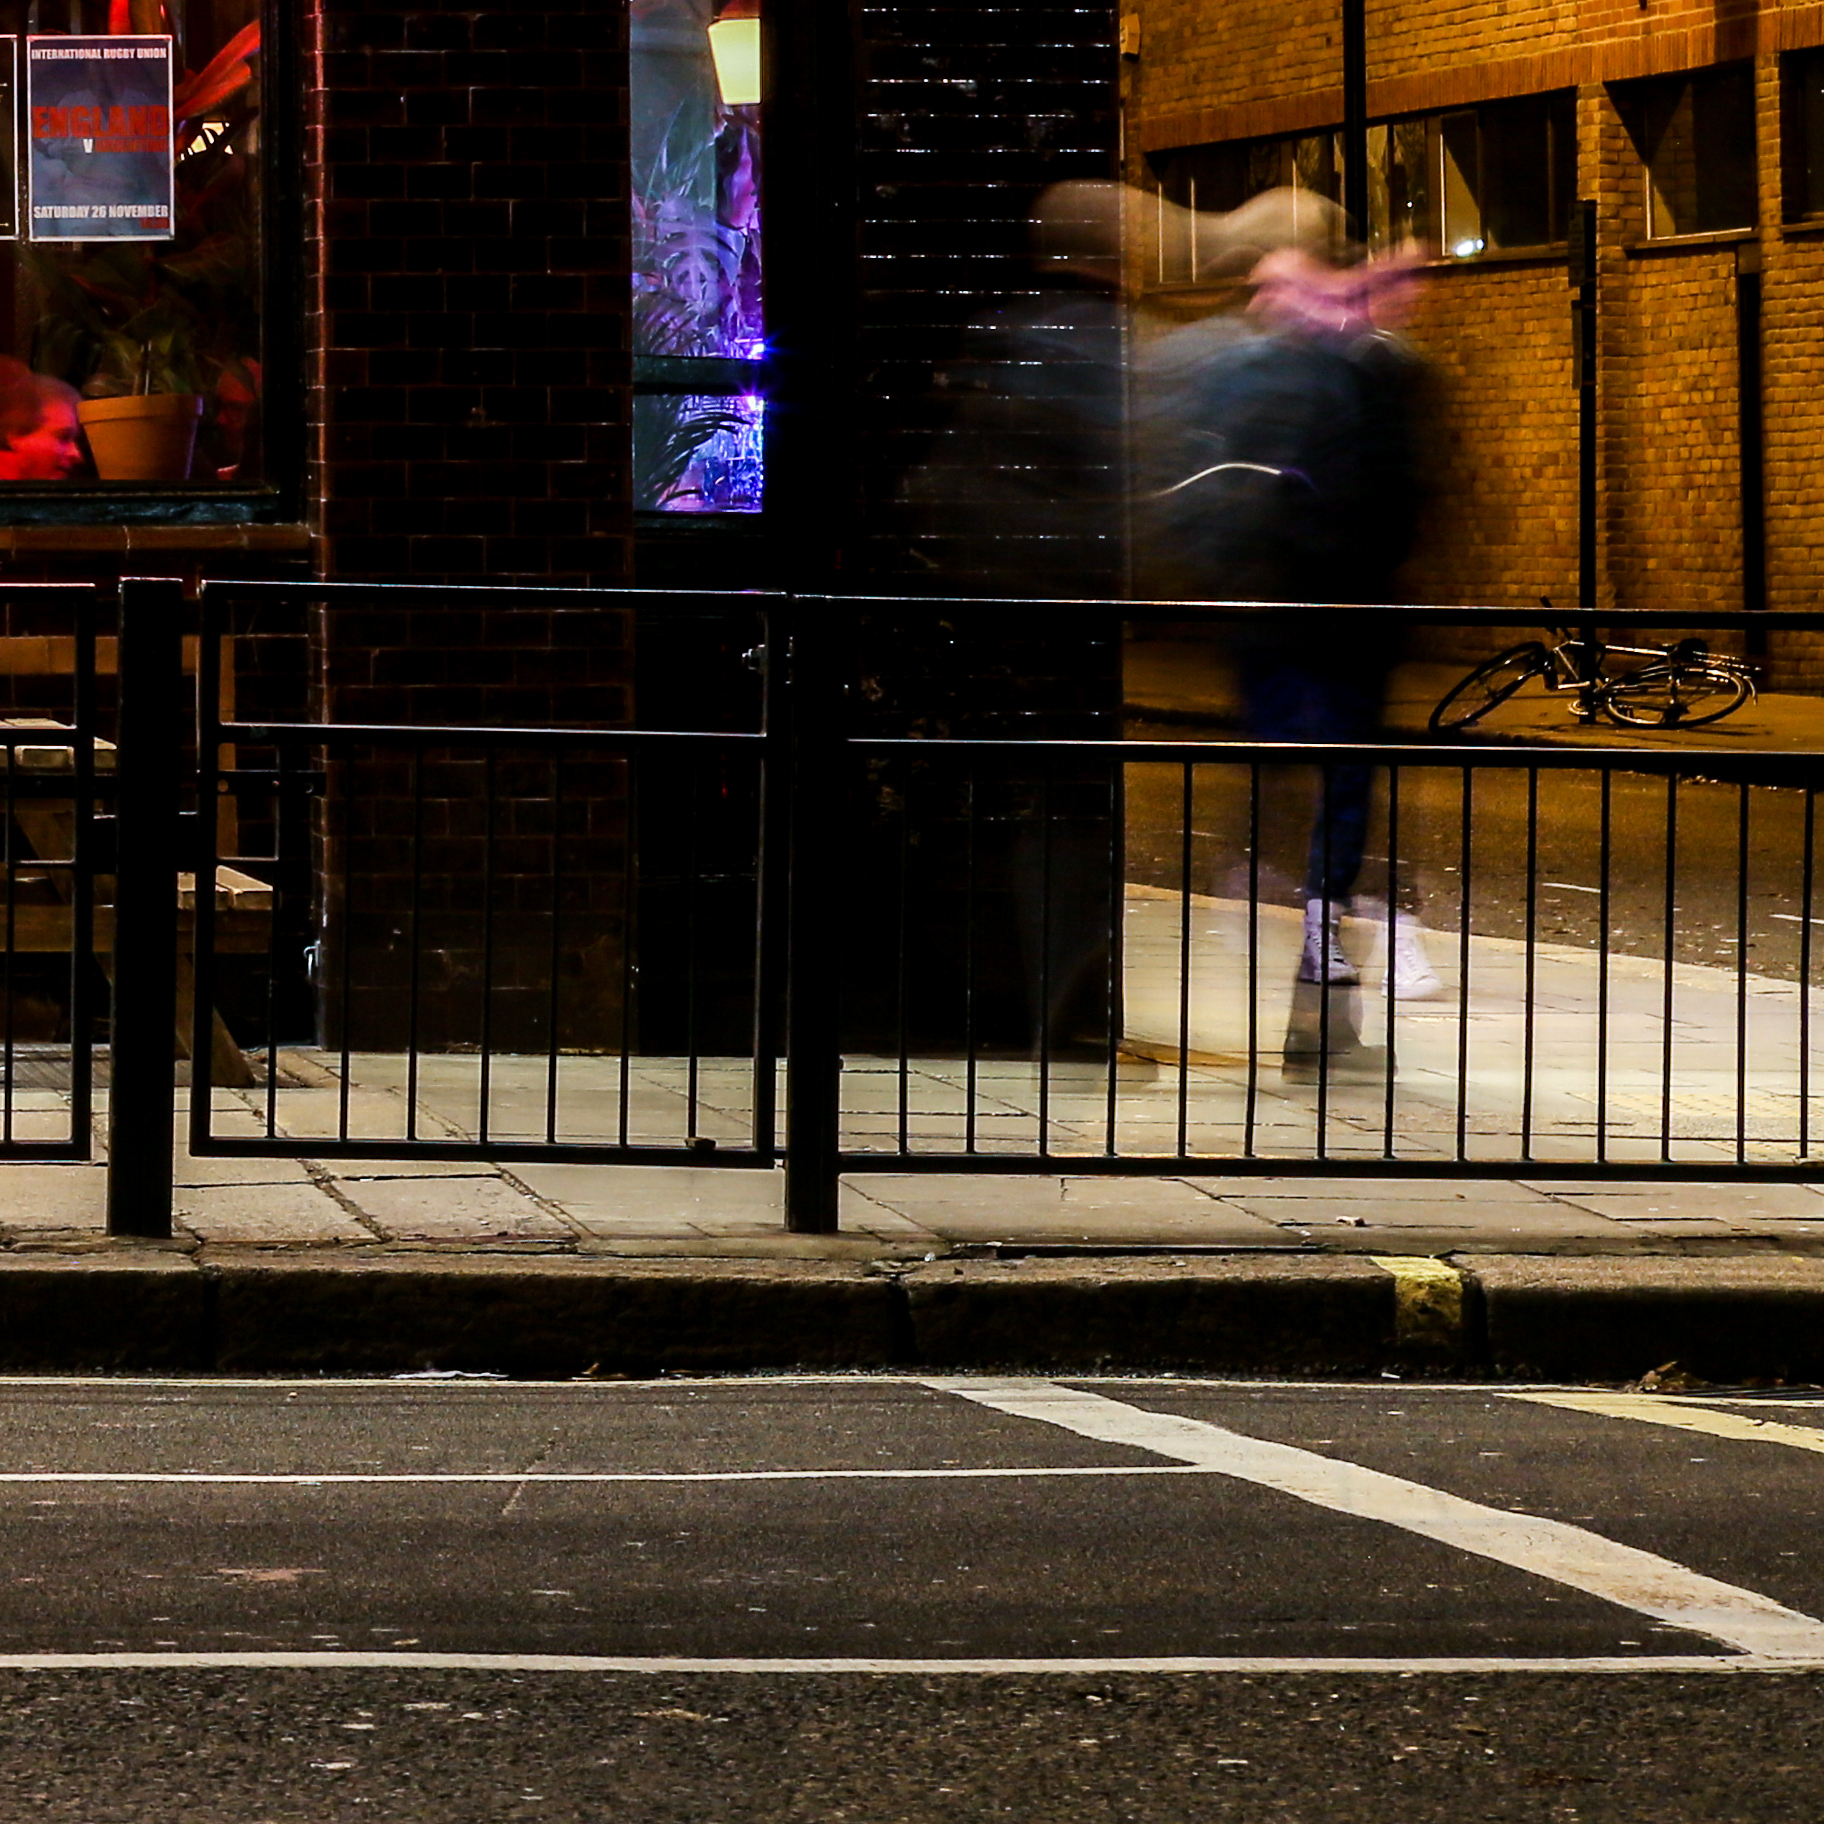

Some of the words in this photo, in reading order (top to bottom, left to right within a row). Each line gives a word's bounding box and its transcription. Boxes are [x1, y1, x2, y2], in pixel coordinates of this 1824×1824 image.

[31, 48, 102, 60] INTERNATIONAL
[103, 48, 135, 59] RUGBY
[137, 47, 167, 58] UNION
[32, 105, 168, 138] ENGLAND
[83, 138, 93, 153] V
[33, 205, 89, 218] SATURDAY
[91, 205, 107, 218] 26
[108, 204, 168, 217] NOVEMBER
